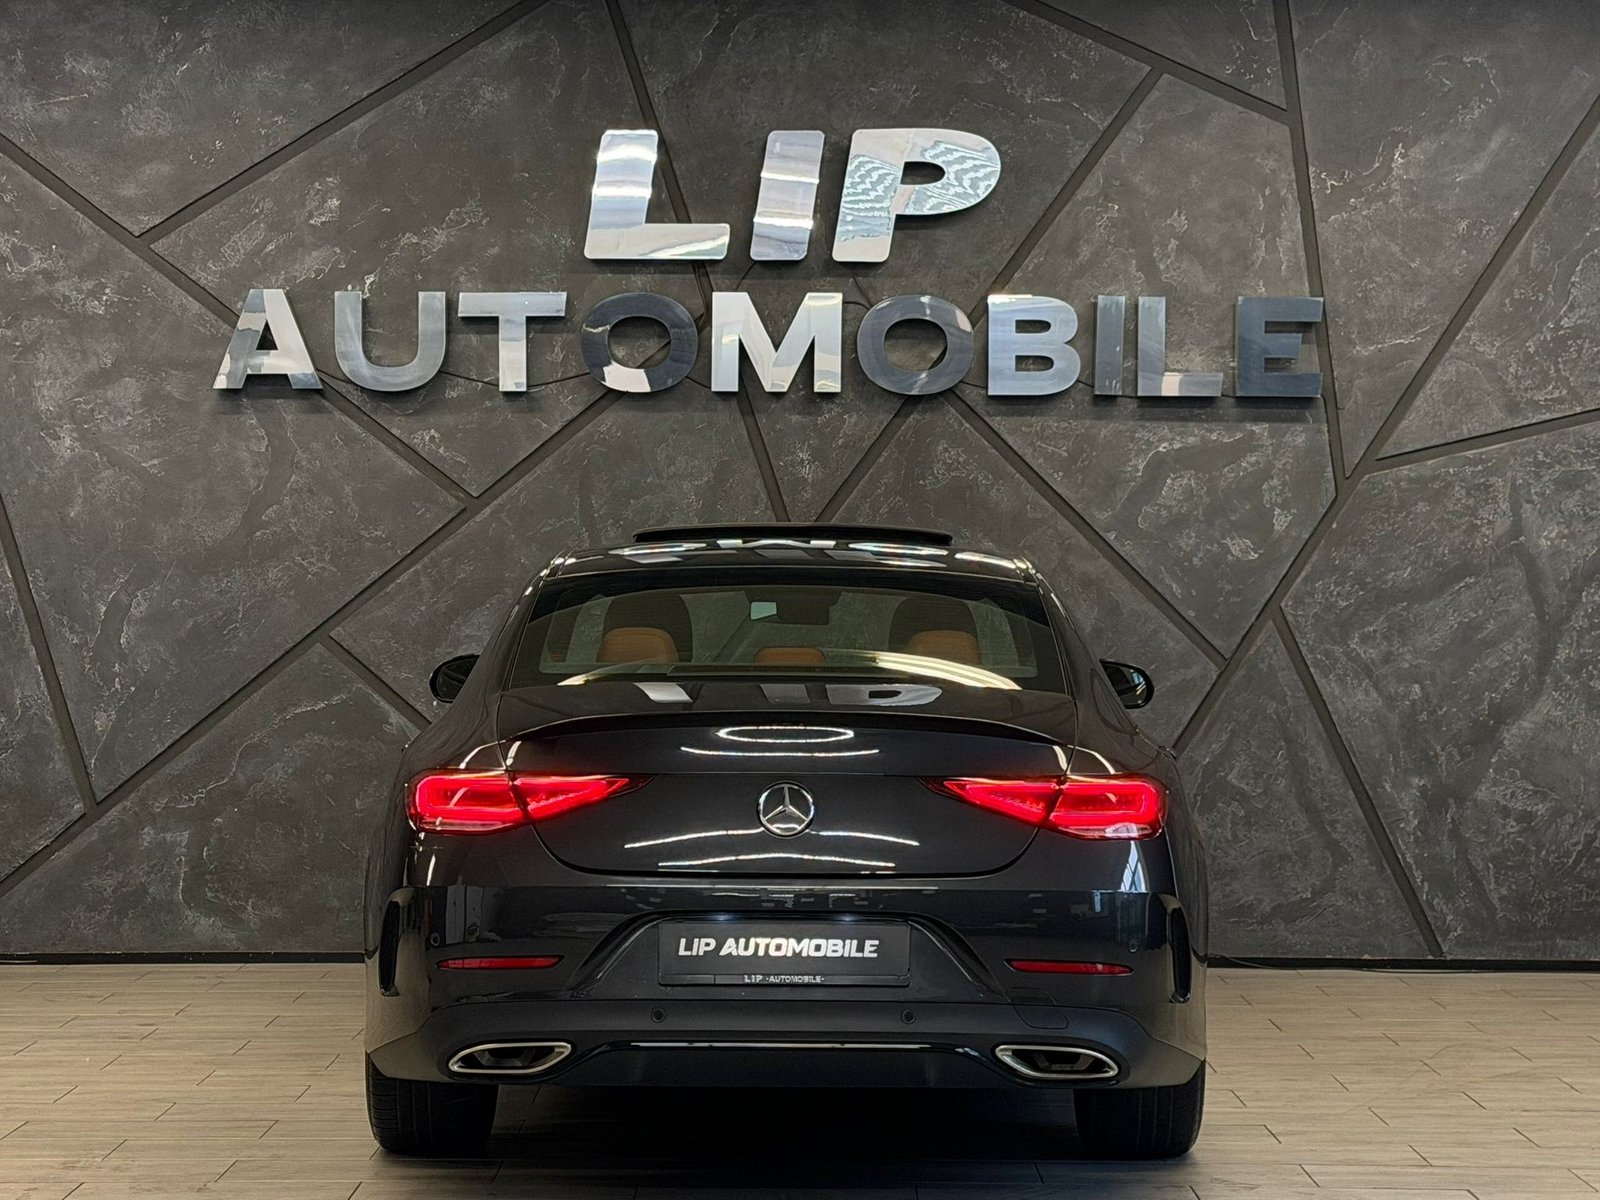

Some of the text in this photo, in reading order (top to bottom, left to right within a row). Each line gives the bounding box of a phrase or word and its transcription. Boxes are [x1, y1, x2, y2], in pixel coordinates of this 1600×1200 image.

[584, 129, 1002, 262] LIP
[212, 289, 1324, 398] AUTOMOBILE
[678, 938, 879, 958] LIP AUTOMOBILE
[744, 975, 763, 983] LIP
